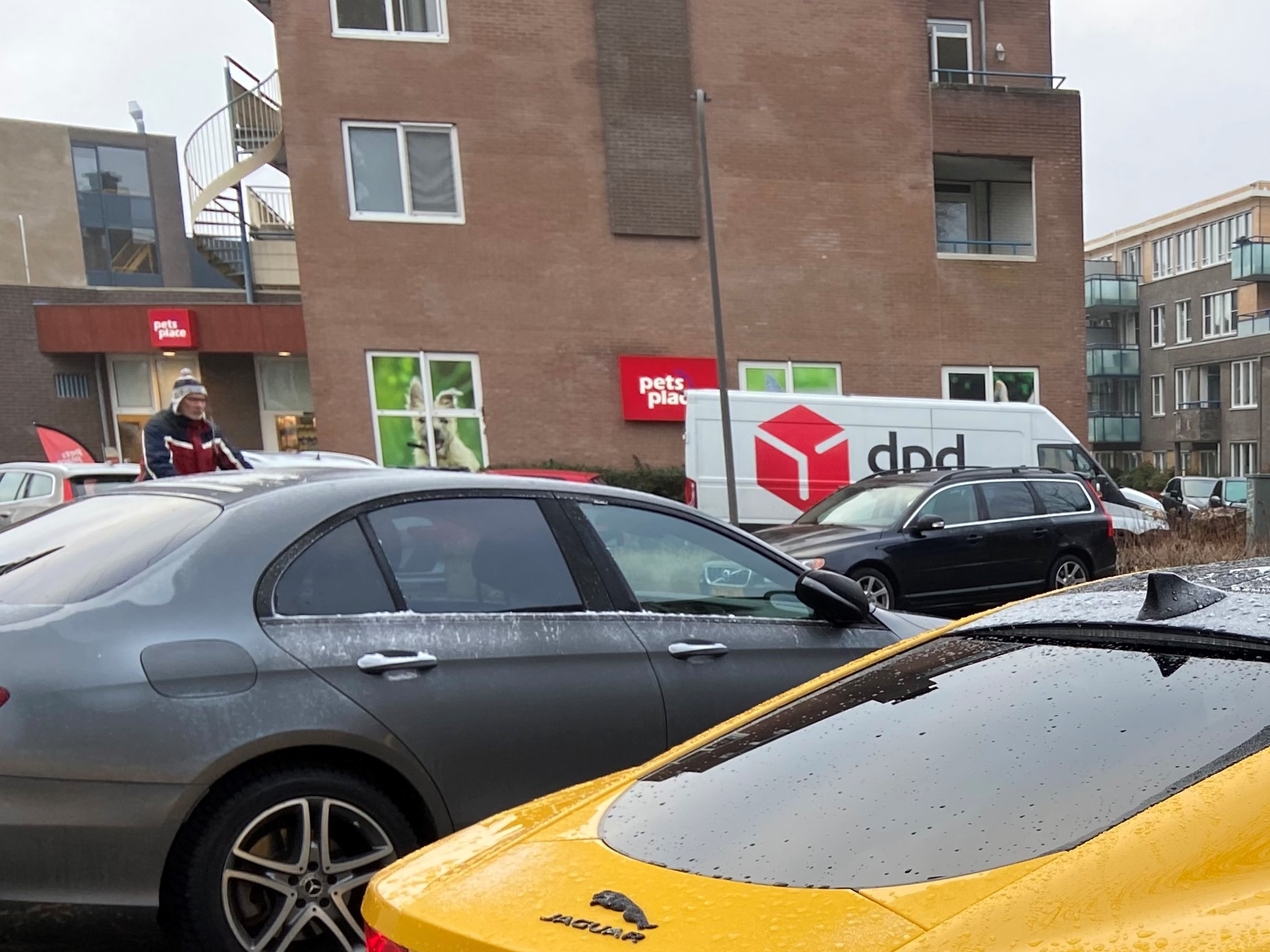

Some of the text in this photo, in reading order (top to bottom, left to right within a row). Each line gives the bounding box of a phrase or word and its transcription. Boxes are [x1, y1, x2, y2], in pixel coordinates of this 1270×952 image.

[153, 319, 178, 332] pets
[158, 328, 187, 340] place
[639, 374, 684, 394] pets
[647, 389, 688, 409] plac
[867, 431, 966, 473] dpd
[540, 913, 645, 944] JAGUAR
